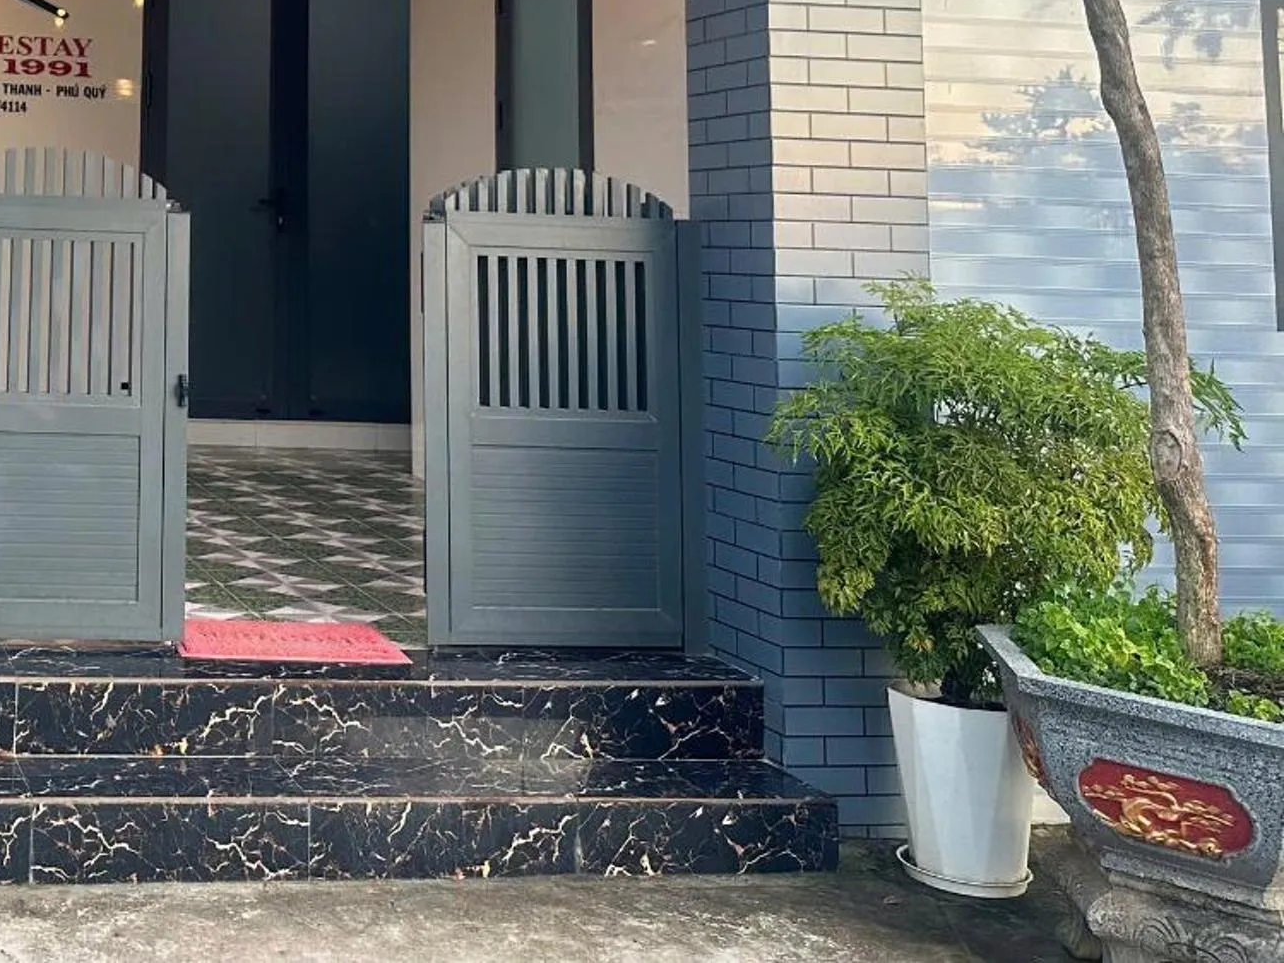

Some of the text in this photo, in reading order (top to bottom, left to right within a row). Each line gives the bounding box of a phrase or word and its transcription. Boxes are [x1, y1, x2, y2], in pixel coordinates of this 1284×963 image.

[3, 57, 92, 77] 1991
[2, 83, 43, 96] THANH
[56, 82, 79, 97] PHÚ
